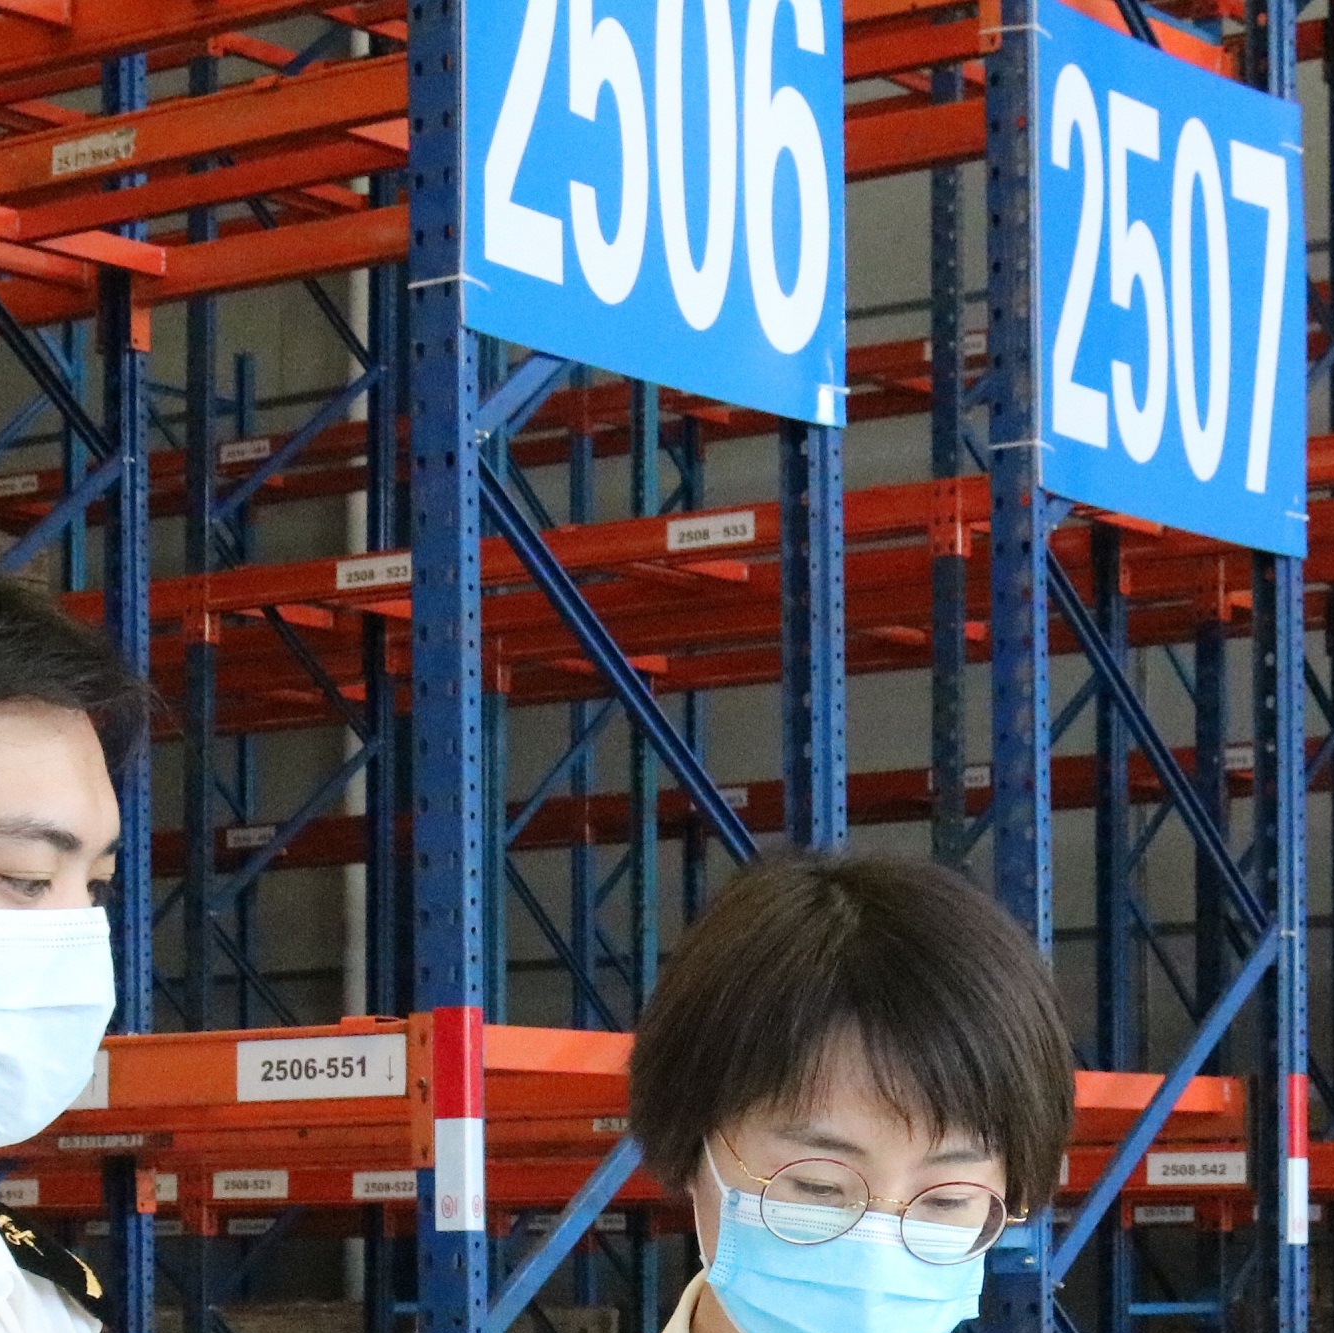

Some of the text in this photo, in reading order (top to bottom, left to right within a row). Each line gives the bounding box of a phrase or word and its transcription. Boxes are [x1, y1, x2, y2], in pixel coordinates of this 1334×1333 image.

[485, 0, 830, 354] 2506
[1051, 63, 1289, 494] 2507
[261, 1056, 367, 1082] 2506-551
